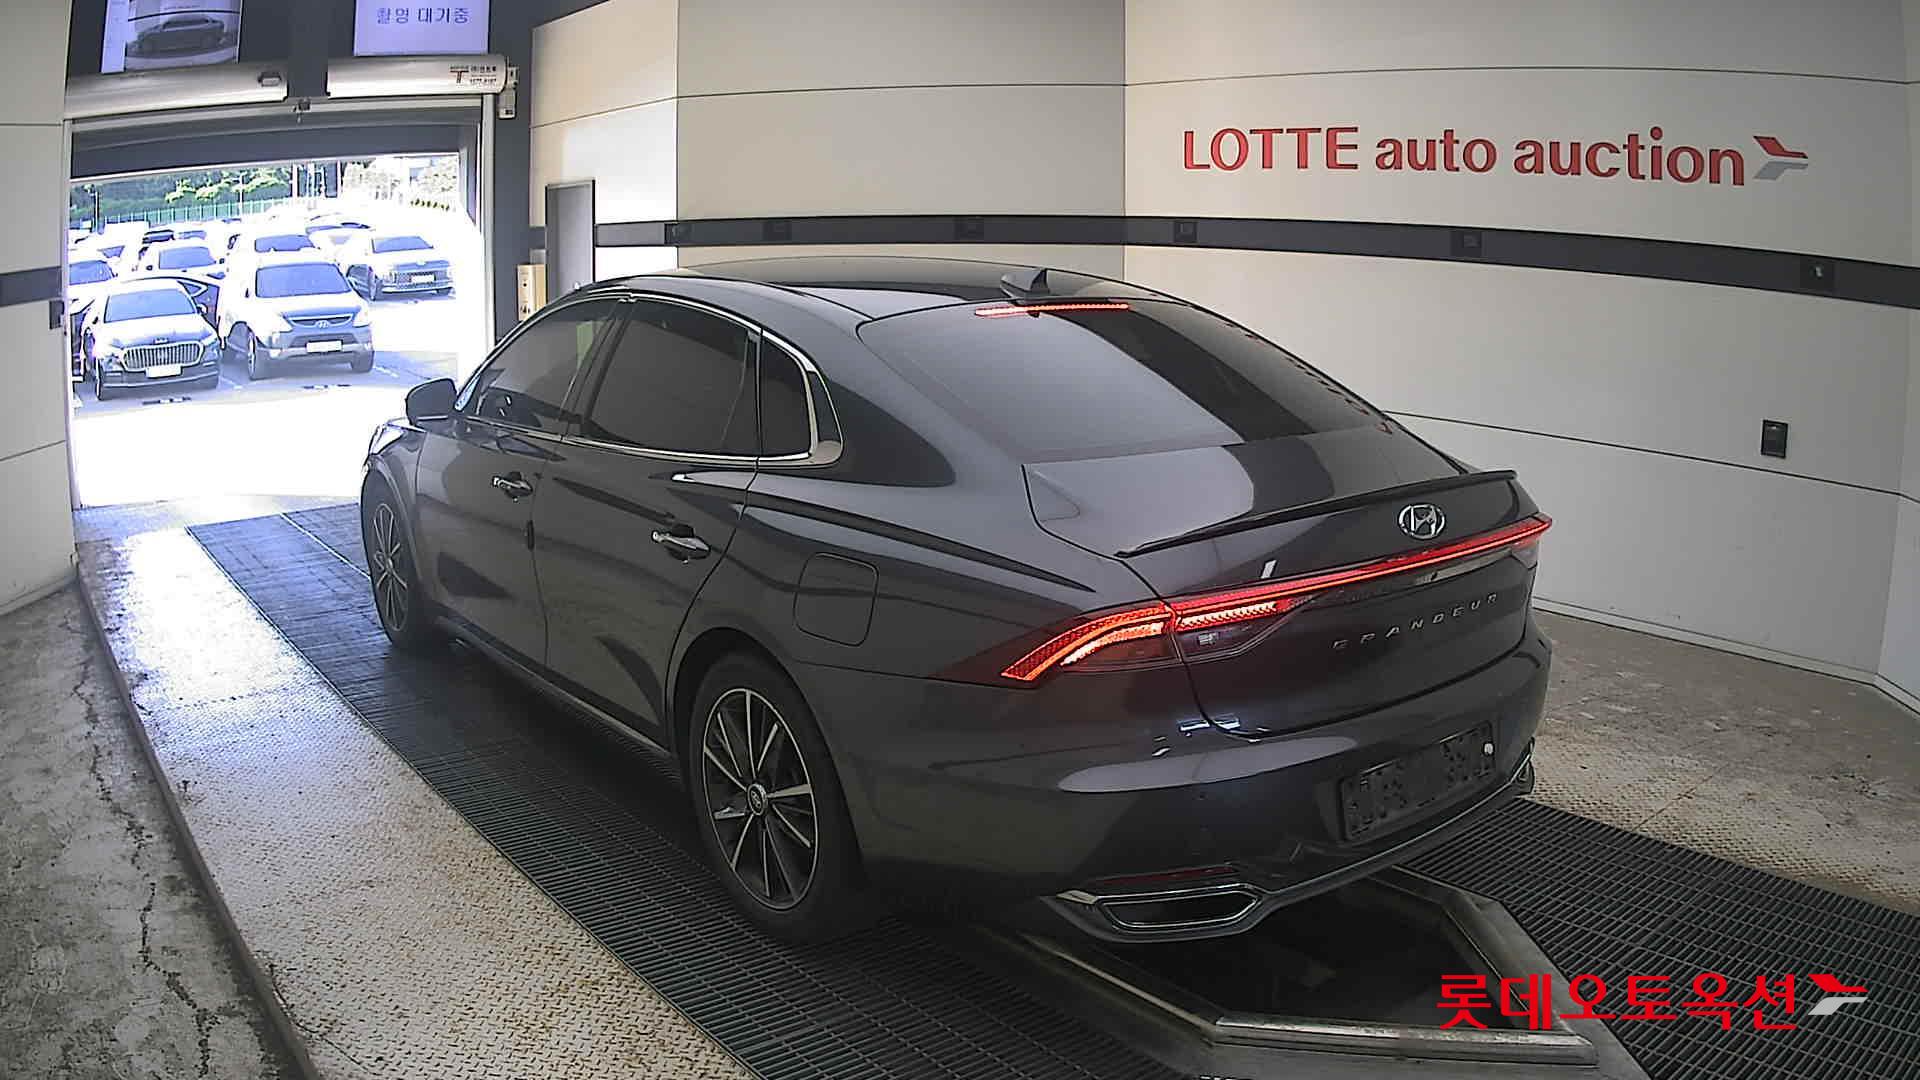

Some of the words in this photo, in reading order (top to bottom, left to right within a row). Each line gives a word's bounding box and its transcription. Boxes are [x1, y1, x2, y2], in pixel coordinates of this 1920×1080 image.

[418, 7, 469, 24] 대기중
[1184, 126, 1359, 171] LOTTE
[1375, 128, 1498, 173] auto
[1512, 126, 1745, 187] auction
[1332, 593, 1498, 649] GRANDEUR
